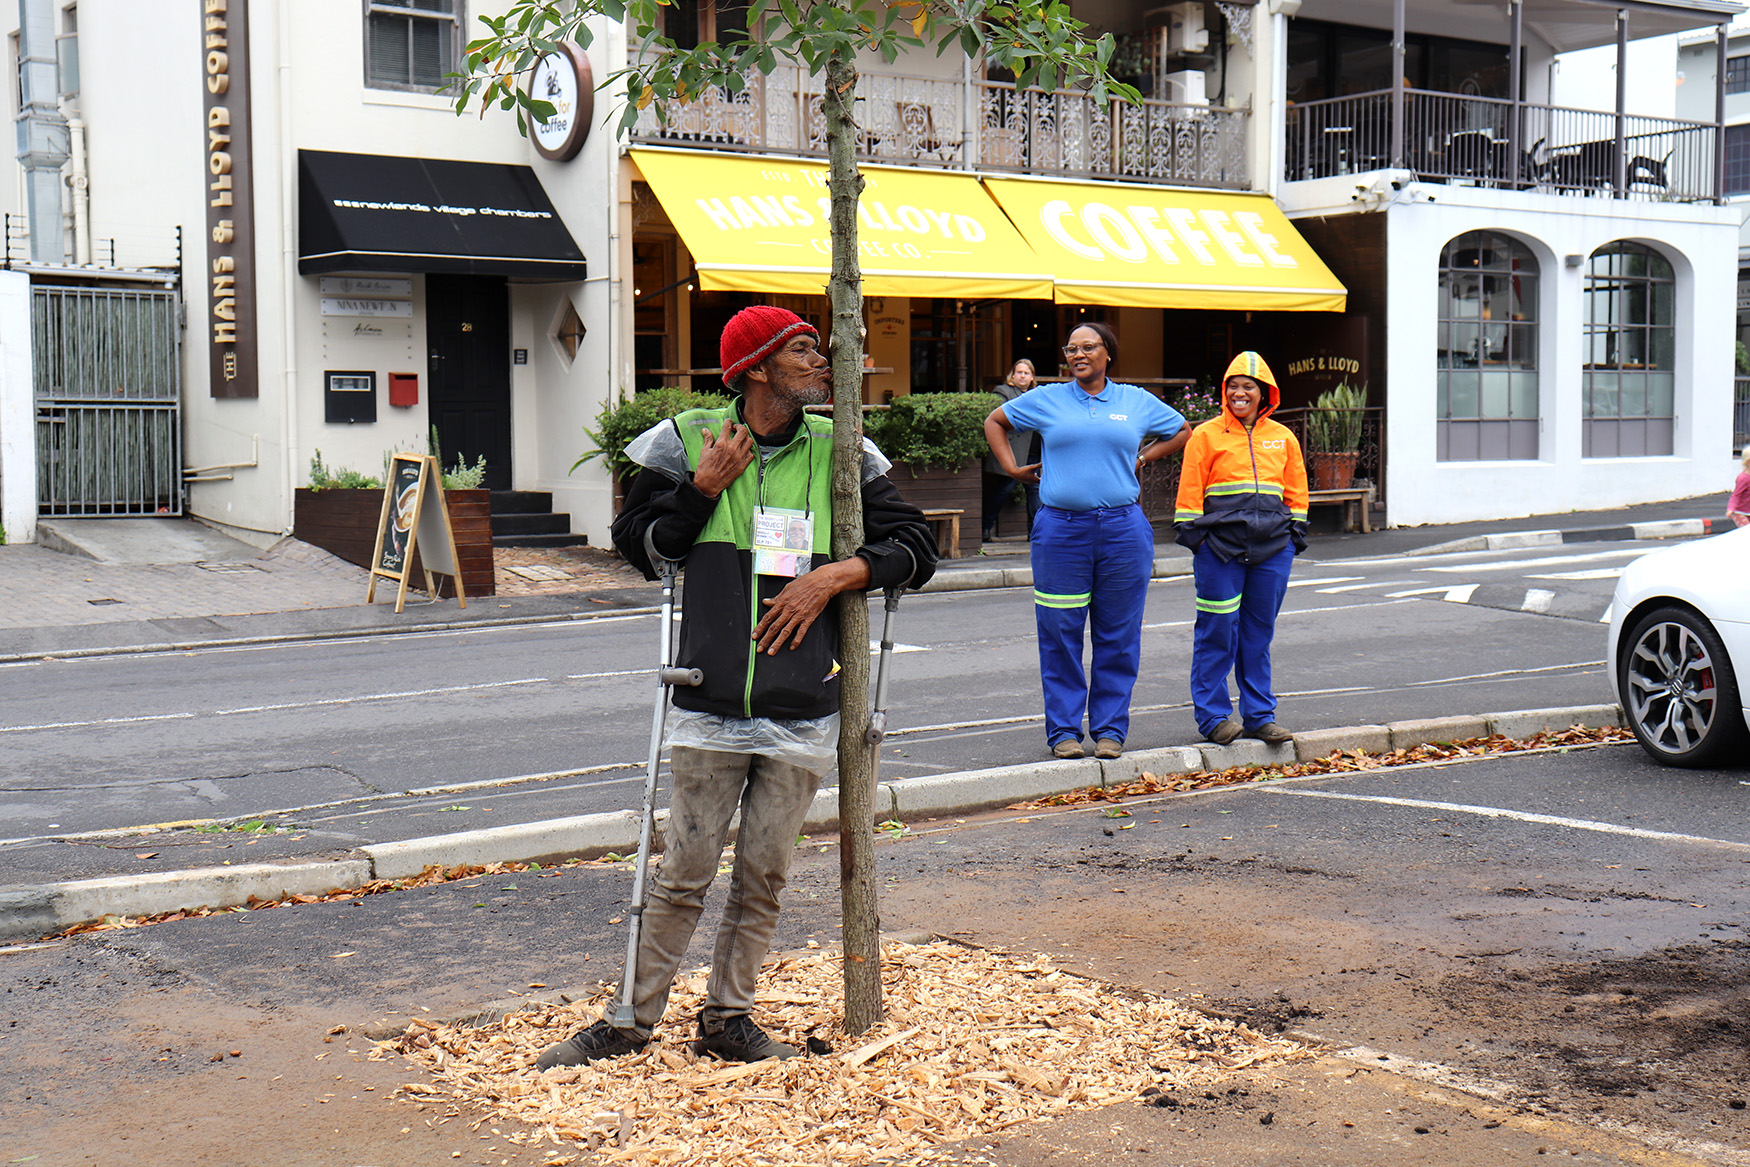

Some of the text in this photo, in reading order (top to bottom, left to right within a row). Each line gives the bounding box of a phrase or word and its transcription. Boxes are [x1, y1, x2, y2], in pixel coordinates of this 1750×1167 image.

[540, 118, 567, 133] coffee
[208, 106, 232, 207] LLOYD
[360, 201, 552, 218] newlands village chambers
[695, 195, 814, 231] HANS
[857, 201, 986, 243] LLOYD
[212, 220, 233, 243] &
[1039, 200, 1298, 268] COFFEE
[811, 238, 890, 257] COEE
[213, 256, 236, 343] HANS
[337, 301, 397, 311] NINA NEWTN
[461, 323, 472, 332] 28
[225, 352, 235, 381] THE
[1288, 357, 1360, 376] HANS & LLOYD
[1262, 440, 1286, 449] CCT
[758, 520, 784, 529] PROJECT
